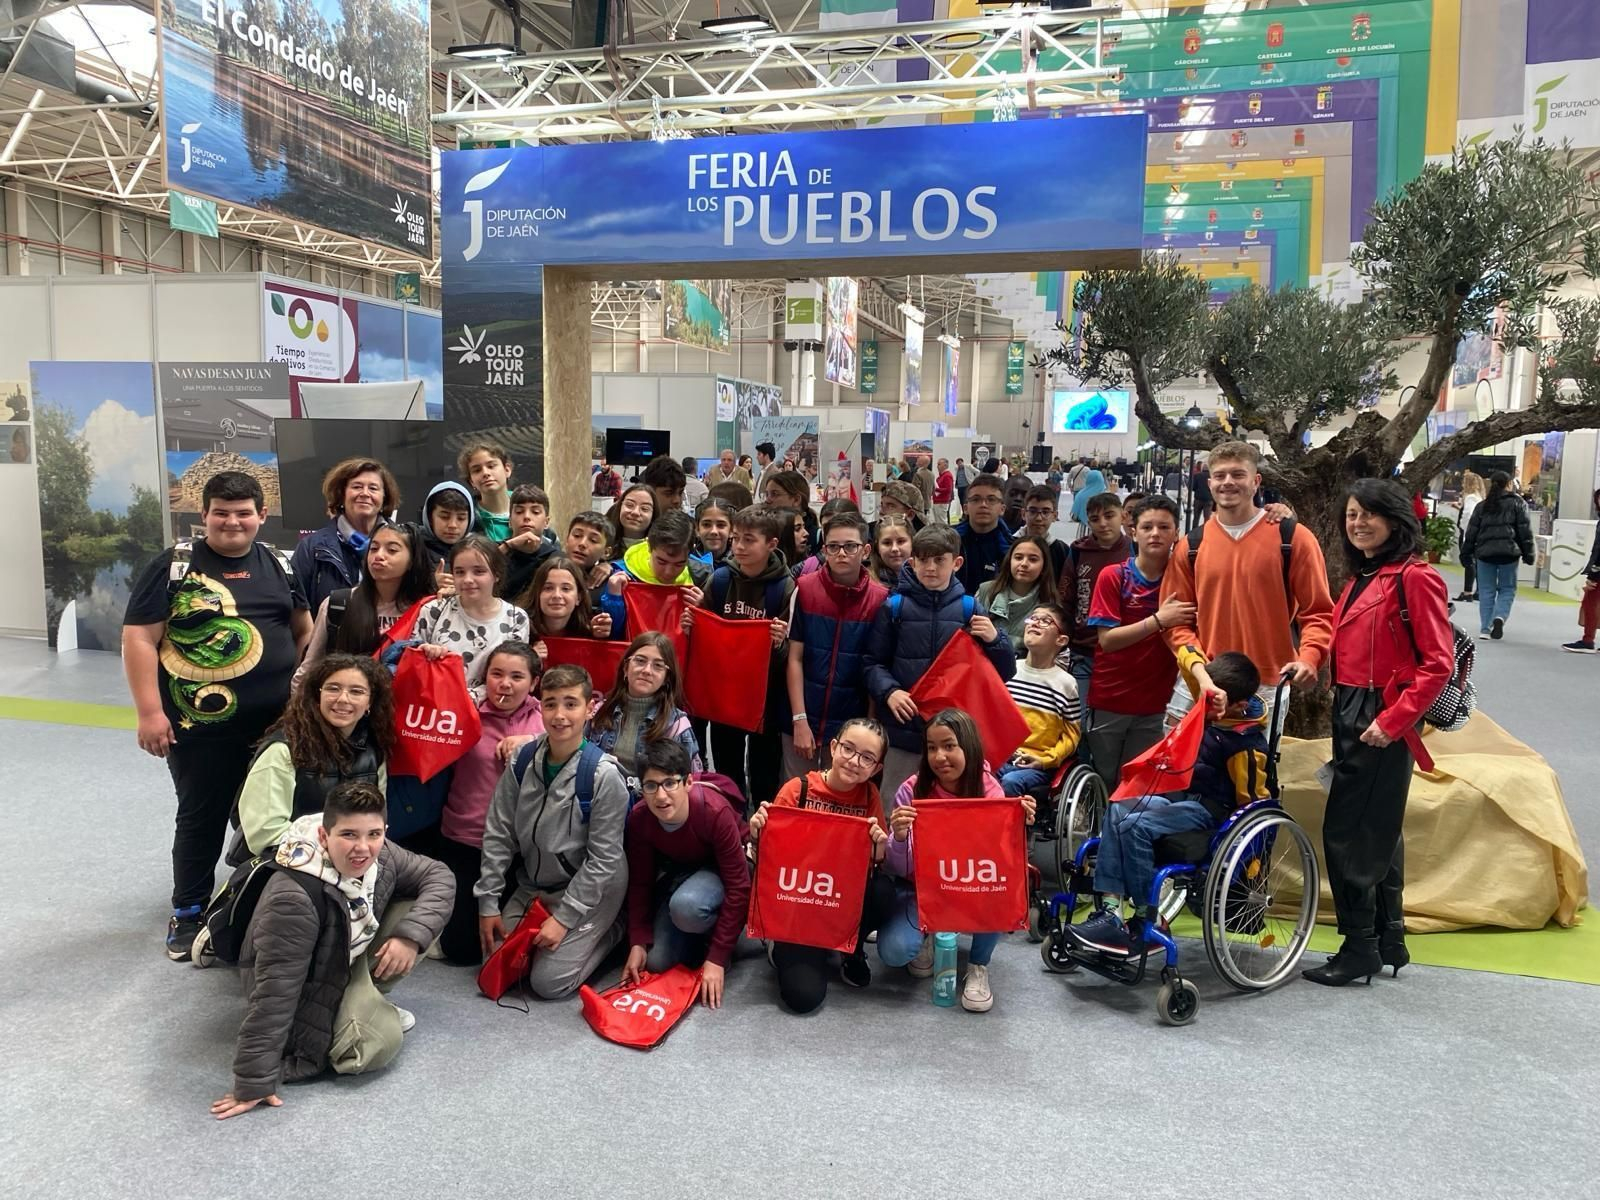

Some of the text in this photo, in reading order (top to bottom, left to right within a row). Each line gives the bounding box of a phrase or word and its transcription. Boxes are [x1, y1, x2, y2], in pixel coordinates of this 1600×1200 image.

[231, 11, 336, 81] Condado
[339, 65, 365, 97] de
[367, 78, 409, 118] Jaén
[840, 66, 851, 74] DE
[1550, 98, 1600, 110] DIPUTACIÓ
[191, 146, 227, 164] DIPUTACIÓN
[688, 150, 832, 190] FERIA DE
[406, 212, 425, 226] OLEO
[487, 206, 566, 222] DIPUTACIÓN
[688, 185, 998, 246] LOS PUEBLOS
[407, 222, 425, 236] TOUR
[487, 224, 539, 238] DE JAÉN
[276, 345, 306, 359] Tiempo
[485, 344, 525, 358] OLEO
[485, 358, 524, 372] TOUR
[172, 367, 207, 379] NAVAS
[244, 368, 272, 380] JUAN
[401, 729, 462, 745] Universidad de Jaén
[940, 884, 980, 892] Universidad
[991, 884, 1007, 892] Jaén
[776, 893, 840, 908] Universidad de Jaén
